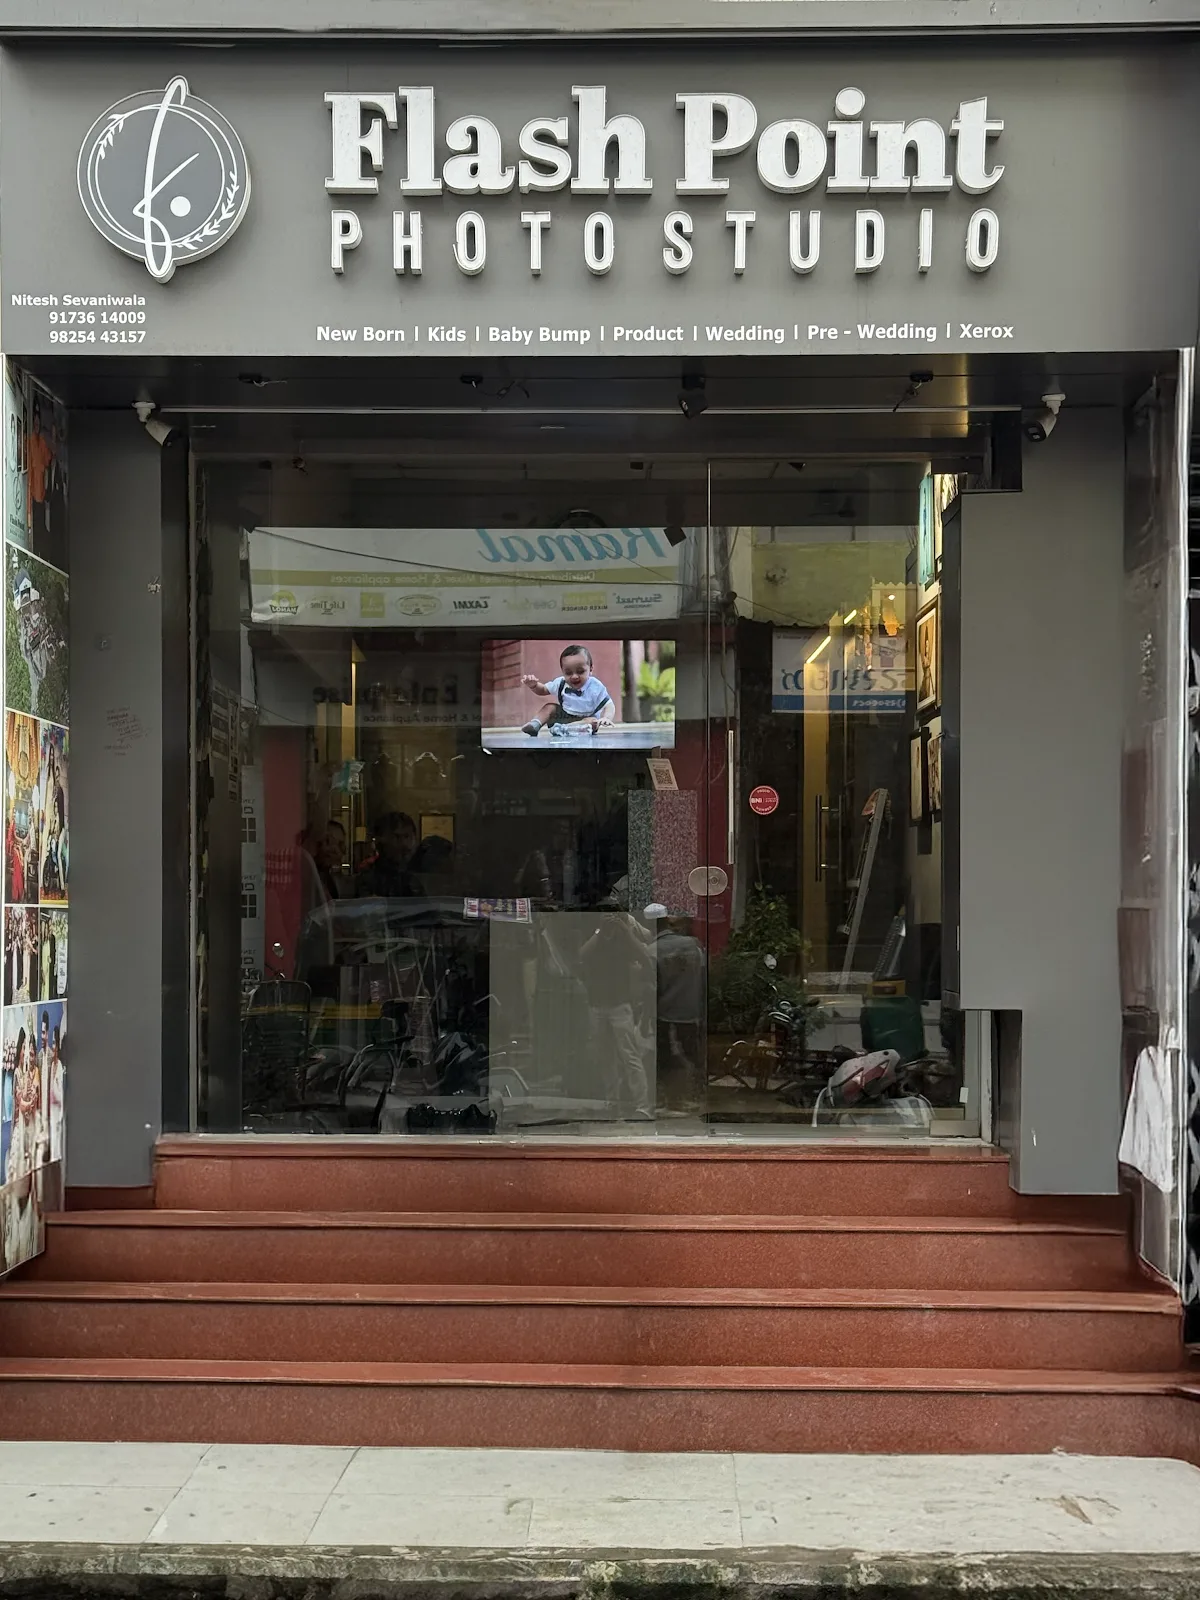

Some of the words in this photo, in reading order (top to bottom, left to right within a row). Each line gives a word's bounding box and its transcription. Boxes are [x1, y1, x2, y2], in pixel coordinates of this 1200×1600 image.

[324, 86, 653, 195] Flash
[675, 87, 1006, 195] Point
[11, 294, 59, 307] Nitesh
[62, 294, 146, 307] Sevaniwala
[48, 311, 96, 325] 91736
[100, 311, 146, 325] 14009
[49, 330, 97, 344] 98254
[100, 330, 147, 344] 43157
[316, 326, 358, 342] New
[363, 326, 406, 342] Born
[427, 325, 467, 342] Kids
[488, 325, 534, 347] Baby
[539, 326, 591, 346] Bump
[613, 325, 685, 341] Product
[705, 324, 785, 346] Wedding
[807, 325, 839, 340] Pre
[857, 323, 937, 343] Wedding
[959, 323, 1014, 340] Xerox
